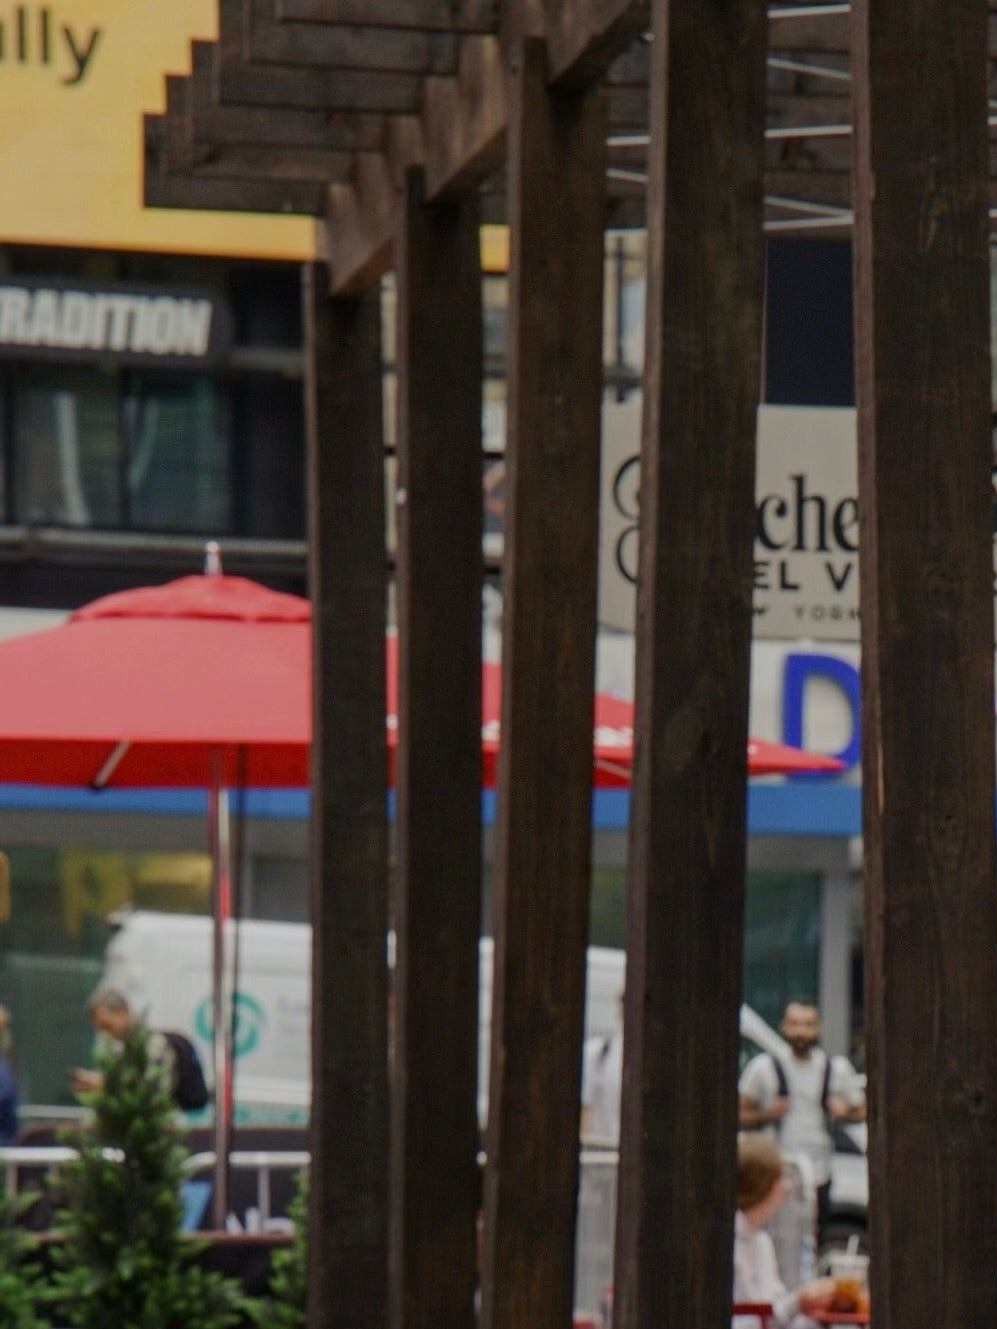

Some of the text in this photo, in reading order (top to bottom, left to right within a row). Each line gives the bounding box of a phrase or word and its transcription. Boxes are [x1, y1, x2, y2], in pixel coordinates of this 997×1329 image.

[0, 5, 101, 86] lly
[0, 286, 212, 357] RADITION
[755, 474, 860, 551] che
[752, 561, 799, 591] EL
